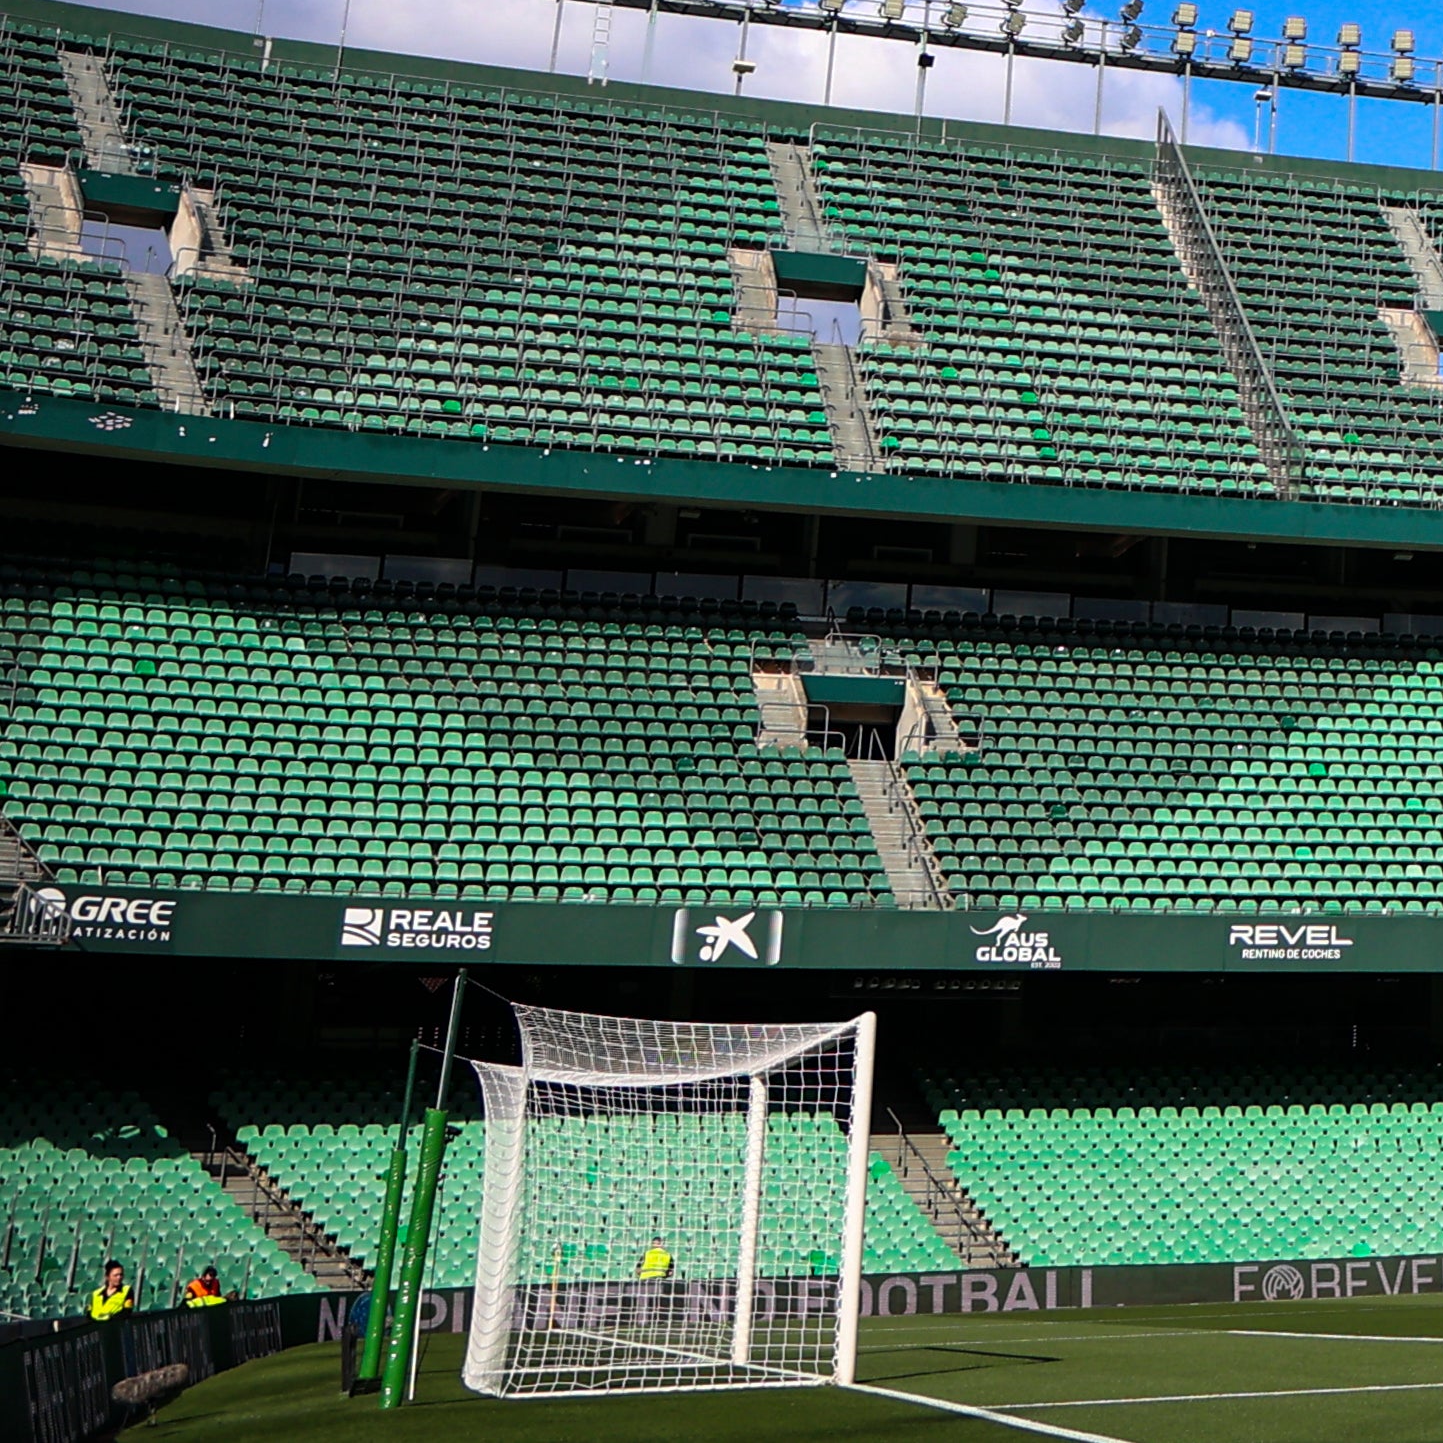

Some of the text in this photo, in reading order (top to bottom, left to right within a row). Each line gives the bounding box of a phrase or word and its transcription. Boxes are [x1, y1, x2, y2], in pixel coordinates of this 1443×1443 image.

[71, 896, 176, 925] GREE
[389, 909, 494, 933] REALE
[386, 933, 491, 949] SEGUROS
[1004, 932, 1048, 947] AUS
[1229, 925, 1354, 945] REVEL
[976, 946, 1061, 962] GLOBAL
[1242, 949, 1341, 958] RENTING DE COCHES
